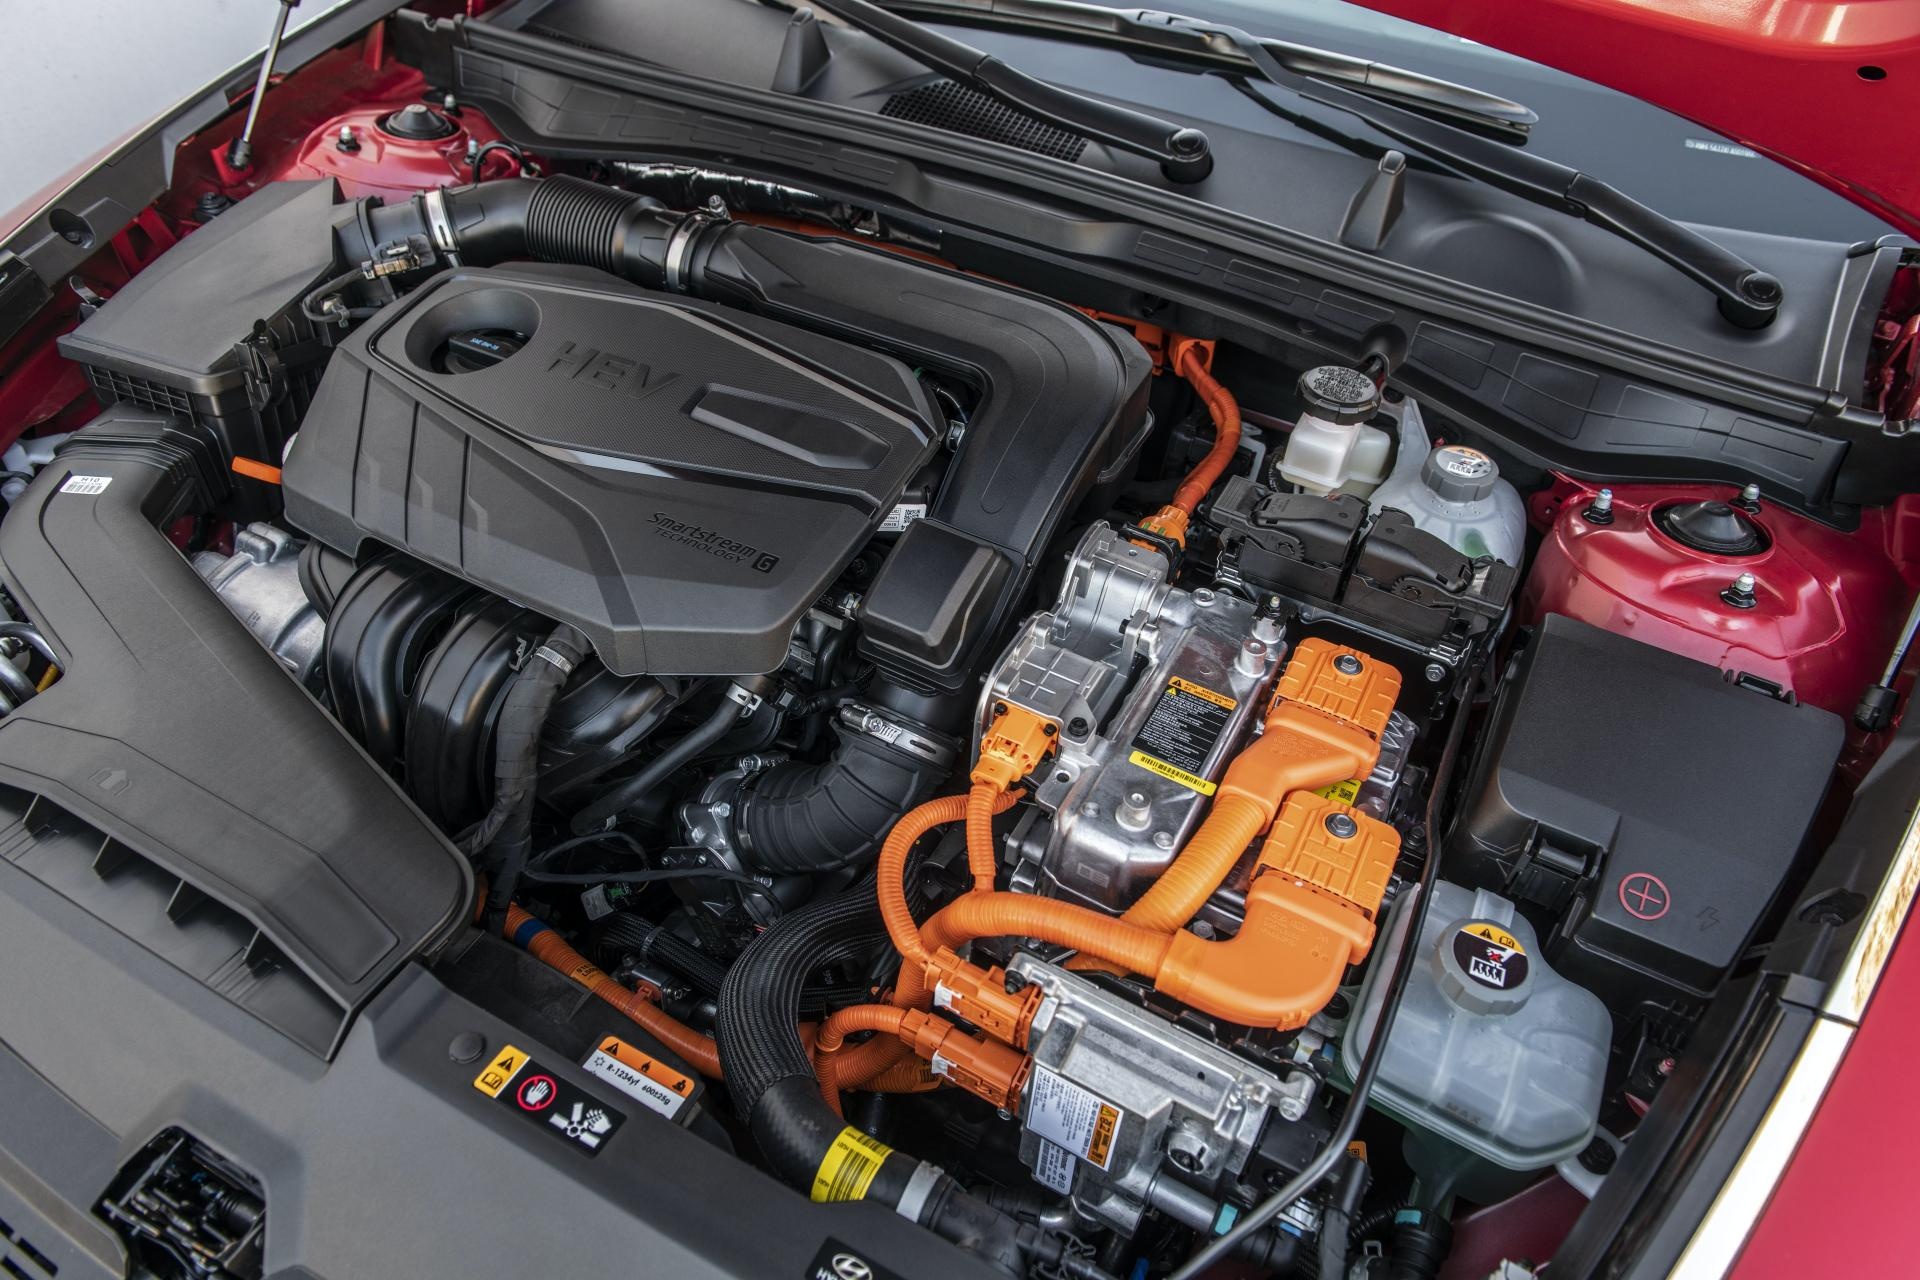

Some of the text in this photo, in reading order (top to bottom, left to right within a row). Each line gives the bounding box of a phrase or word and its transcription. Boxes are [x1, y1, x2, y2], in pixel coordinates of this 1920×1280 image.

[544, 340, 681, 400] HEV
[647, 512, 757, 558] Smartstream
[655, 527, 746, 563] TECHNOLOGY
[606, 1063, 671, 1105] R-1234yf 600±25g
